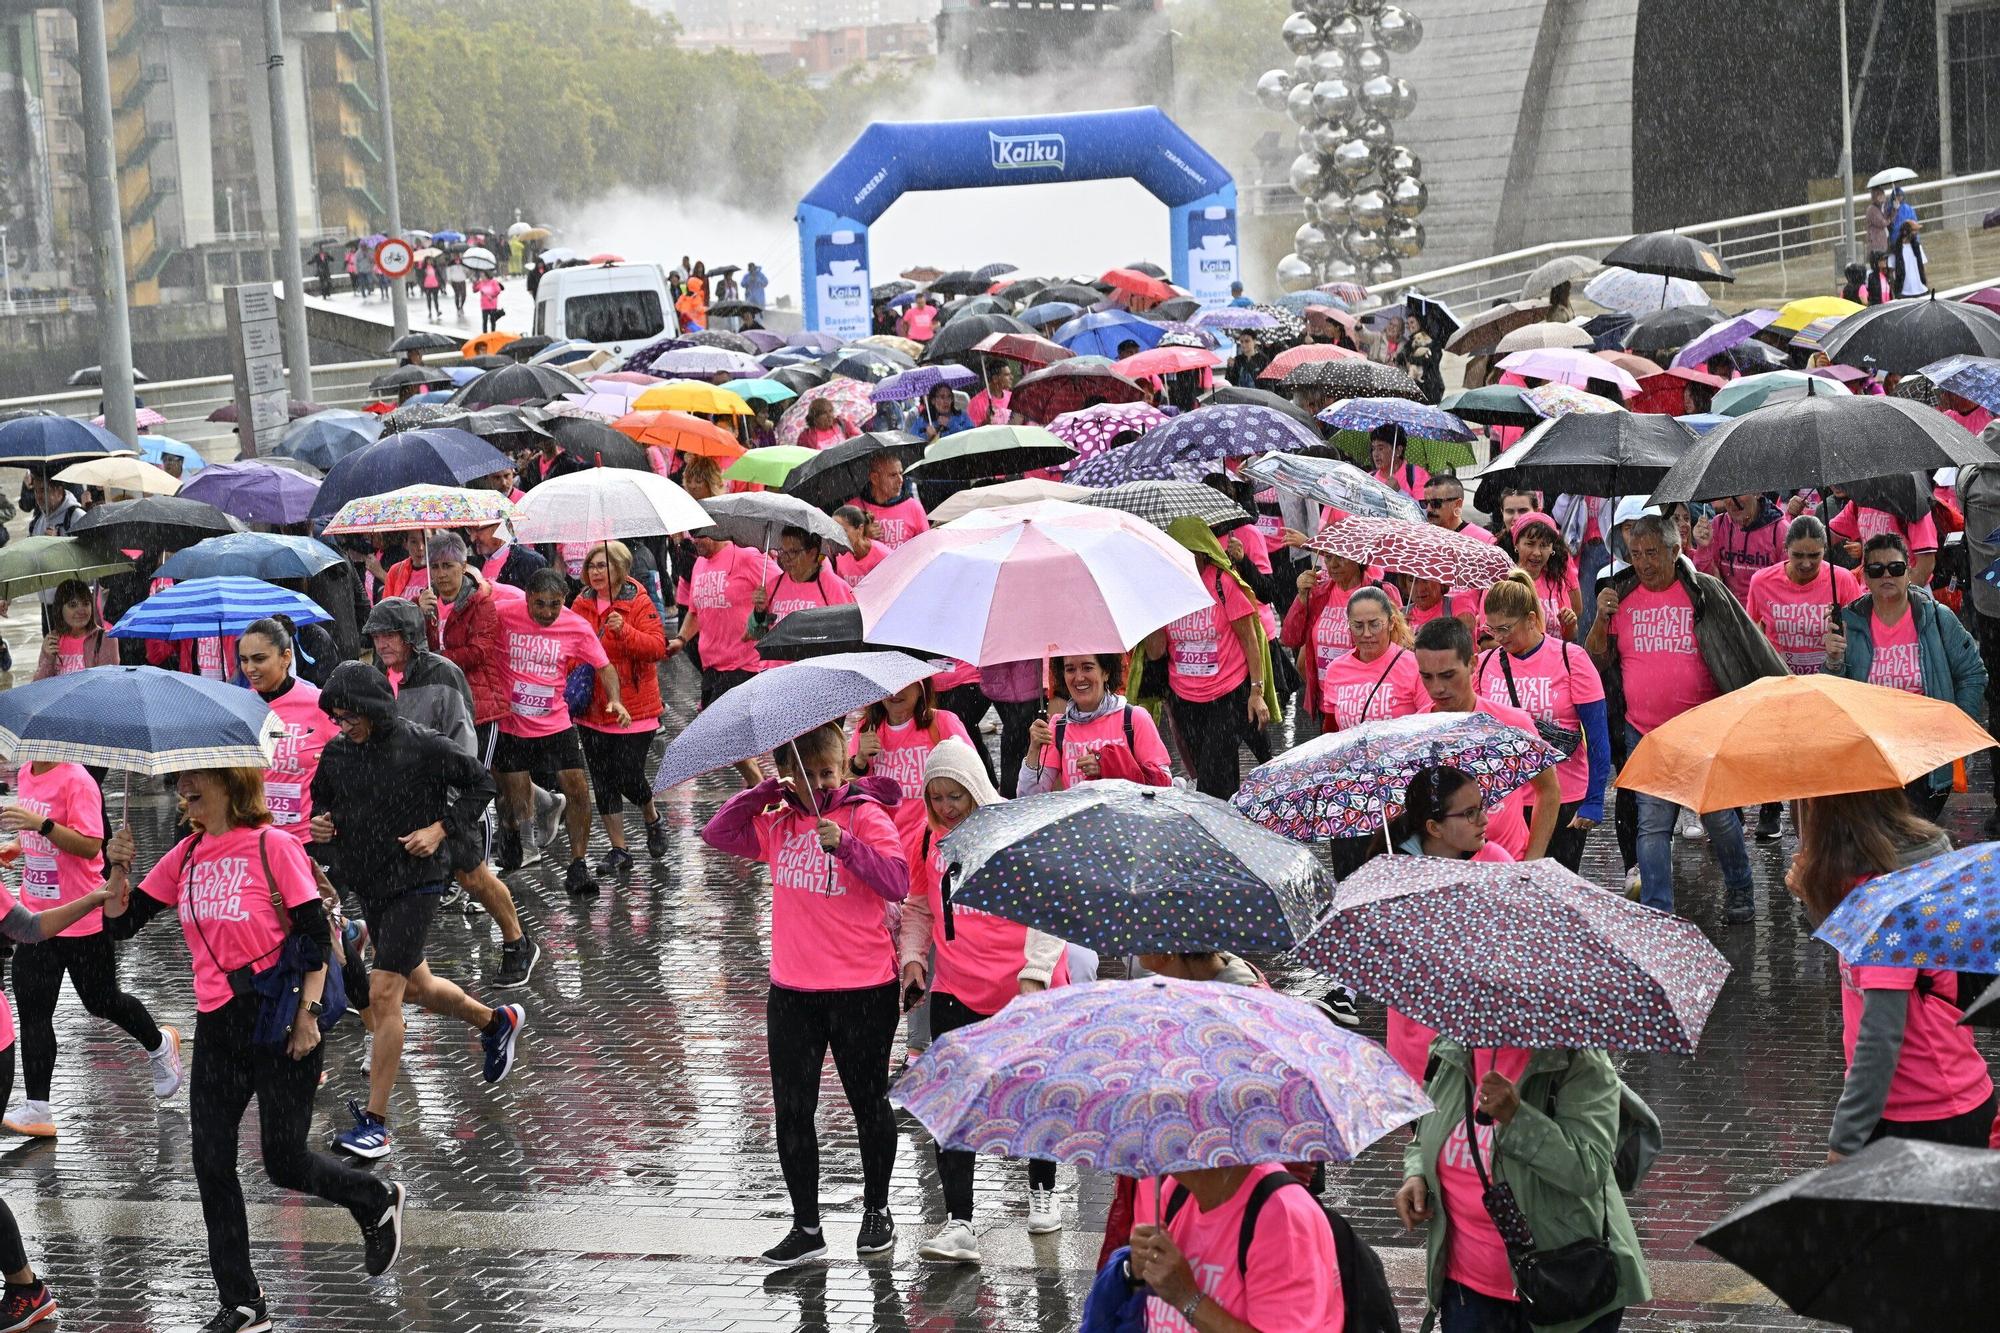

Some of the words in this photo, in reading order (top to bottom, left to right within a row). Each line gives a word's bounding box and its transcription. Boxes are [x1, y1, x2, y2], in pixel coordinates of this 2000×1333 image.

[999, 140, 1058, 167] Kaiku
[1202, 260, 1230, 273] Kaiku
[828, 286, 860, 299] Kaiku
[1634, 635, 1698, 654] AVANZA
[1181, 652, 1208, 664] 2025
[519, 694, 547, 707] 2025
[265, 798, 289, 811] 025
